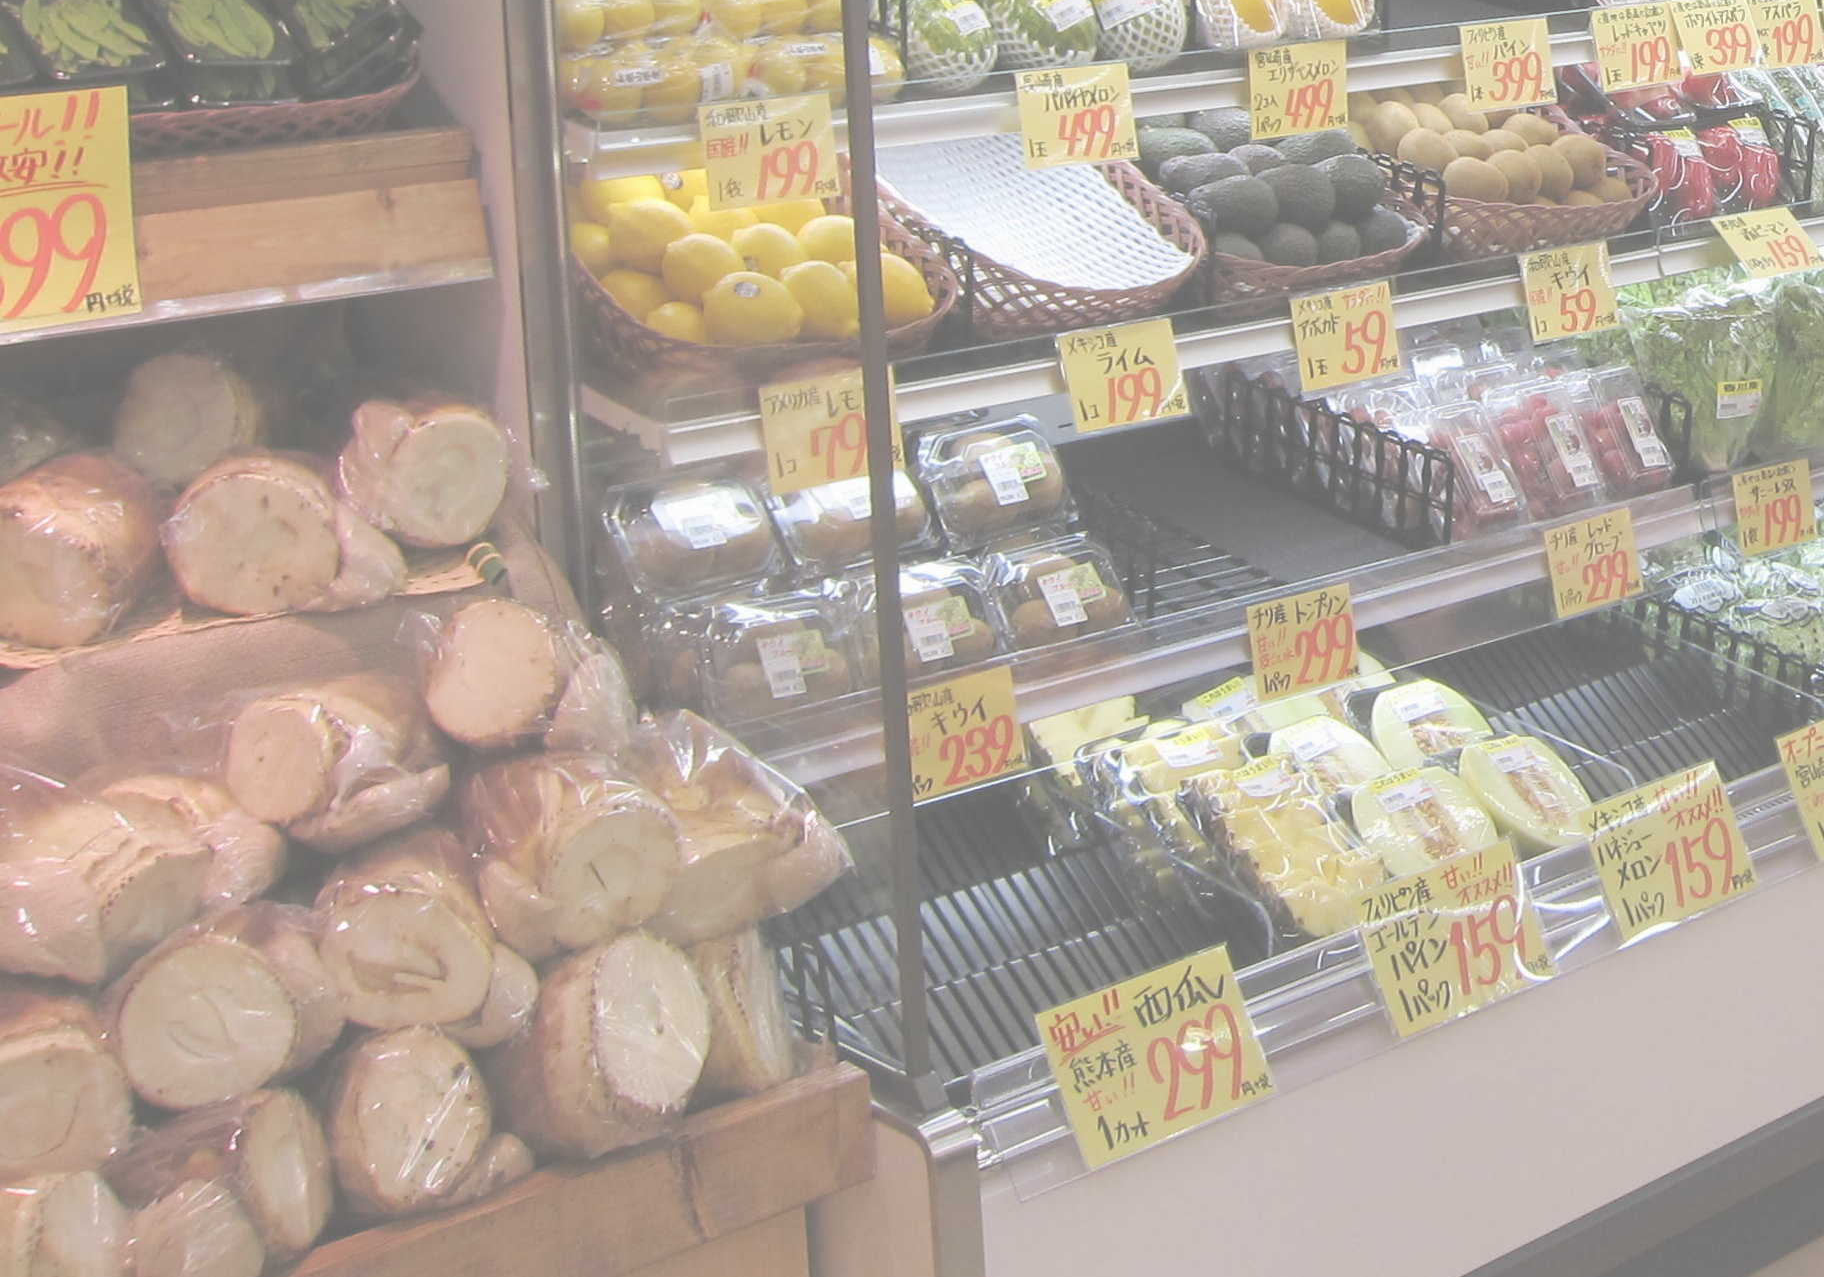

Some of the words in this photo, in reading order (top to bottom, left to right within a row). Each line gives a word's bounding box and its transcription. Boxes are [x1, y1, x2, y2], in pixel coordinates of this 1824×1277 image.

[1684, 6, 1745, 28] ホワイトアスパラ
[1762, 0, 1801, 20] アスパラ
[1494, 40, 1530, 59] パイン
[1631, 36, 1671, 83] 199
[1706, 24, 1751, 65] 399
[1772, 14, 1813, 63] 199
[1489, 51, 1542, 101] 399
[1284, 78, 1334, 129] 499
[759, 119, 814, 147] レモン
[1058, 104, 1117, 158] 499
[757, 141, 820, 200] 199
[0, 193, 107, 319] 99
[1767, 235, 1810, 269] 159
[1551, 265, 1589, 289] キウイ
[1561, 289, 1596, 331] 59
[1096, 347, 1154, 375] ライム
[1342, 310, 1387, 374] 59
[764, 386, 822, 415] アメリカ産
[826, 389, 860, 417] レモ
[1106, 366, 1162, 423] 199
[810, 412, 867, 478] 79
[1587, 517, 1612, 538] レッド
[1763, 494, 1801, 546] 199
[1584, 531, 1623, 560] グローブ
[1582, 551, 1628, 602] 299
[1253, 602, 1288, 630] チリ産
[1295, 613, 1353, 684] 299
[930, 695, 987, 735] キウイ
[939, 714, 1013, 786] 239
[1588, 794, 1645, 842] メキシコ産
[1667, 785, 1723, 829] オススメ!!
[1456, 862, 1513, 906] オススメ!!
[1617, 854, 1662, 888] メロン
[1664, 817, 1733, 907] 159
[1361, 875, 1433, 924] フィリピン産
[1442, 853, 1482, 889] 甘い!!
[1622, 893, 1664, 926] 1パック
[1369, 905, 1440, 952] ゴールデン
[1448, 895, 1527, 994] 159
[1391, 935, 1447, 980] パイン
[1399, 979, 1450, 1022] 1パック
[1069, 1040, 1137, 1093] 熊本産
[1147, 1004, 1242, 1121] 299
[1083, 1072, 1135, 1111] 甘い!!
